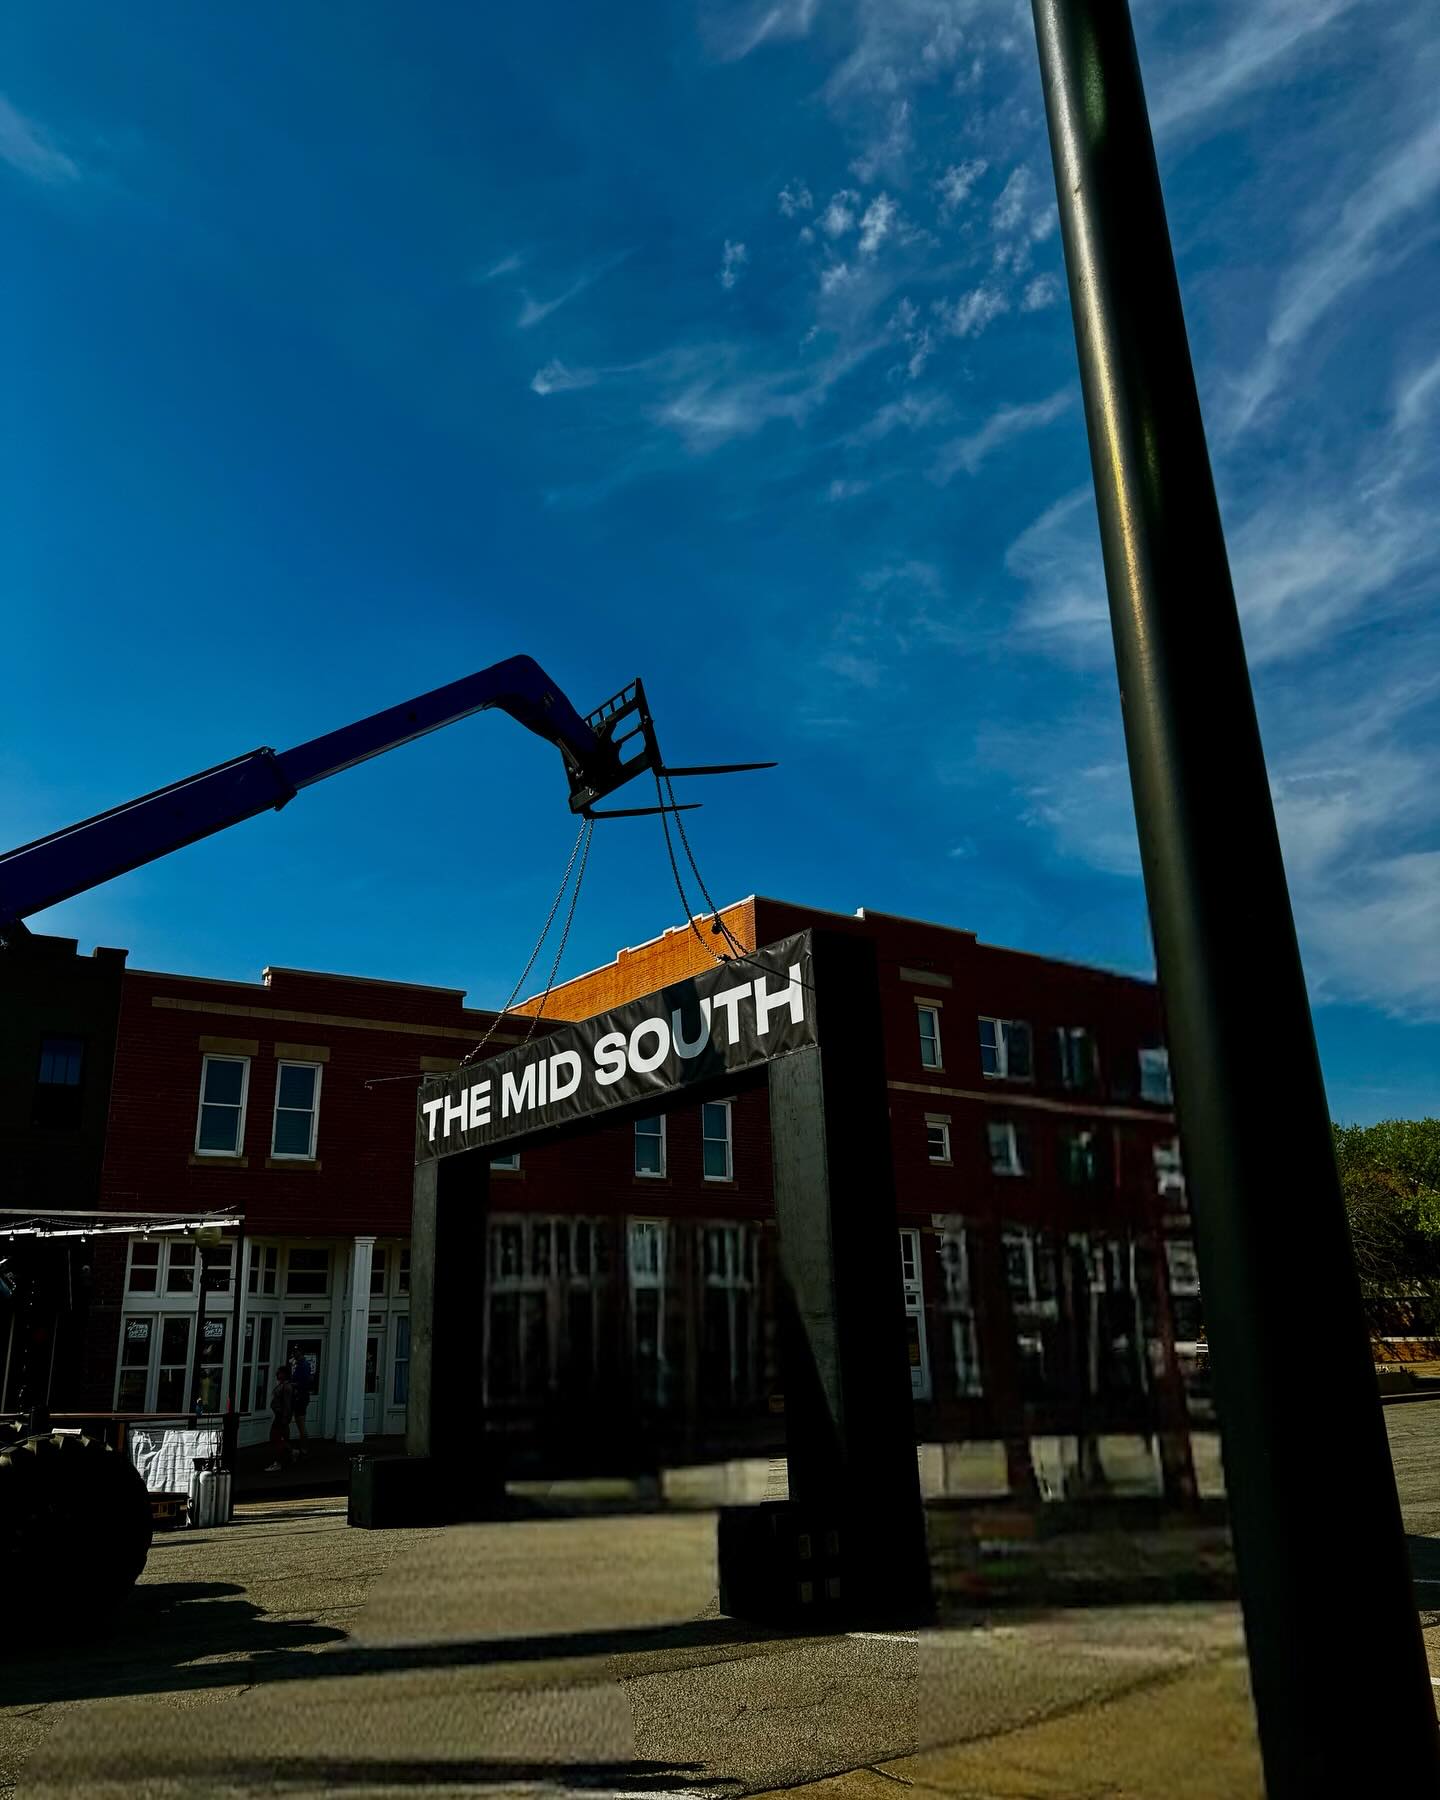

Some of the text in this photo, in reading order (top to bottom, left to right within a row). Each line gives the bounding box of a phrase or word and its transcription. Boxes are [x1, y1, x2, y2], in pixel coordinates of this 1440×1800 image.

[423, 963, 804, 1142] THE MID SOUTH
